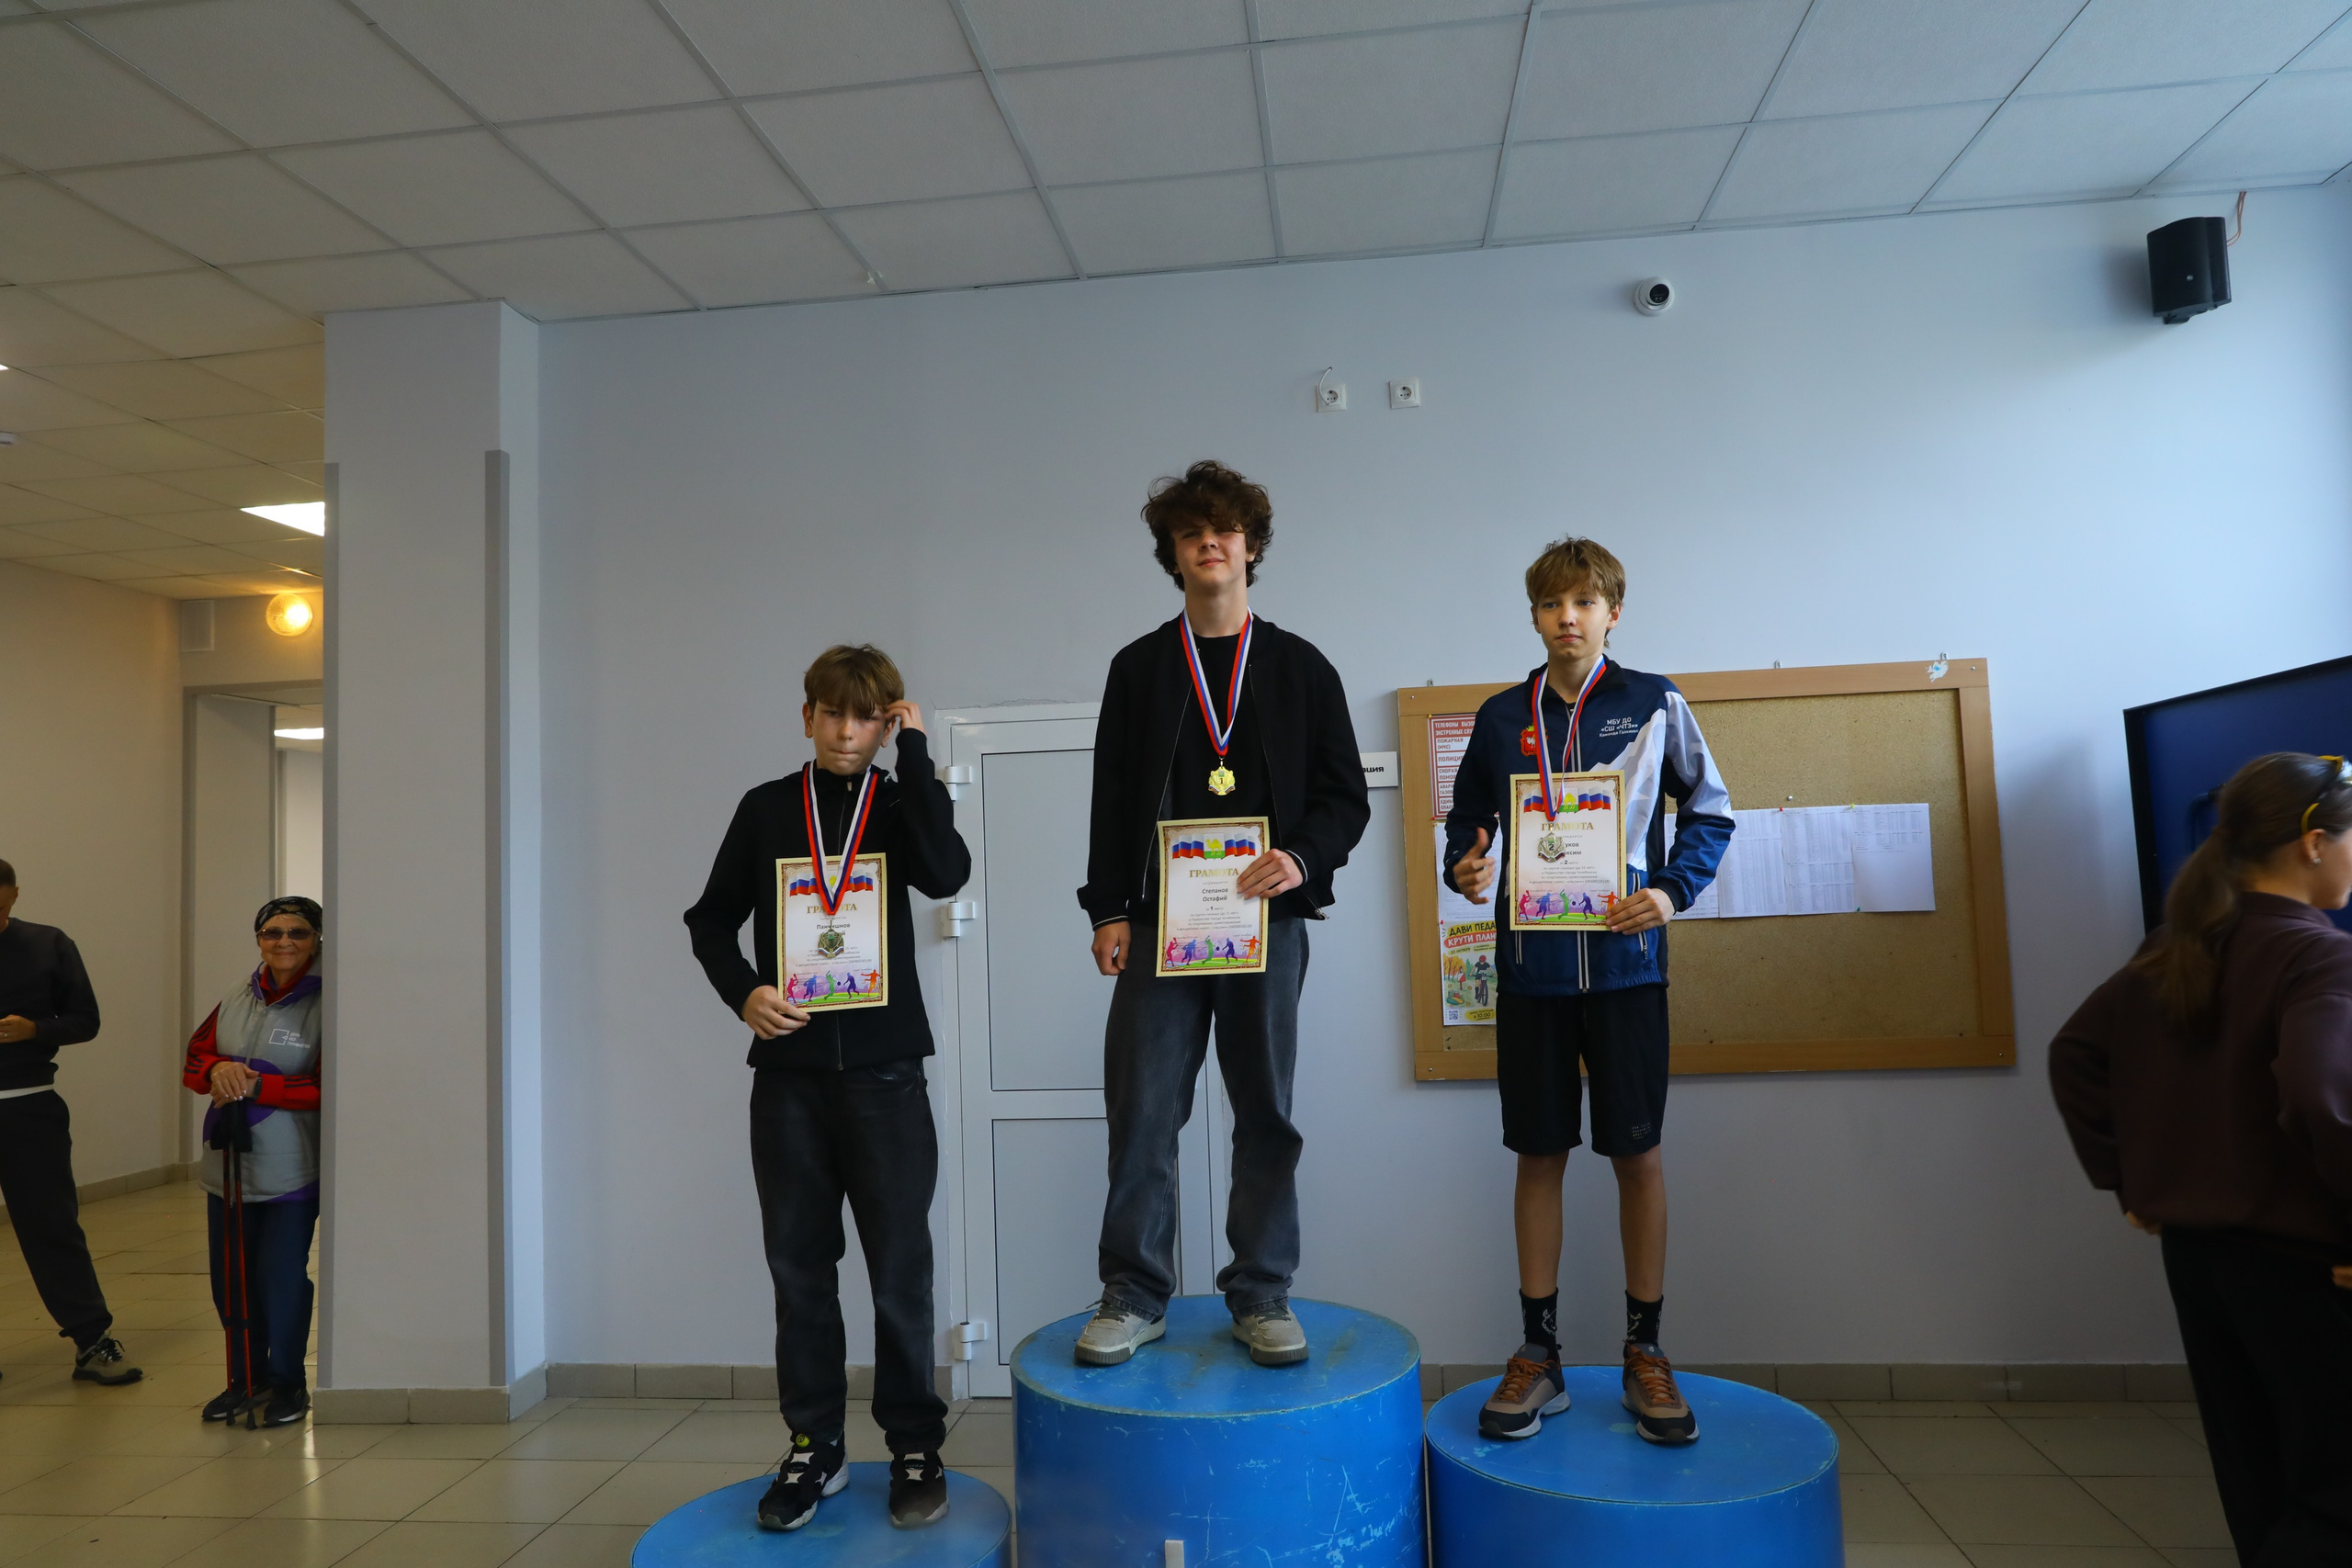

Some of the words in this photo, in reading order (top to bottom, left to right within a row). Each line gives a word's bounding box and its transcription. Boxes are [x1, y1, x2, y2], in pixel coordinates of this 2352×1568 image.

[1548, 843, 1555, 852] 2
[1189, 868, 1239, 878] ГРАМОТА
[1449, 924, 1473, 937] ДАВИ
[1475, 922, 1496, 931] ПЕДА
[1448, 934, 1474, 947] КРУТИ
[1476, 932, 1497, 942] ПЛАН
